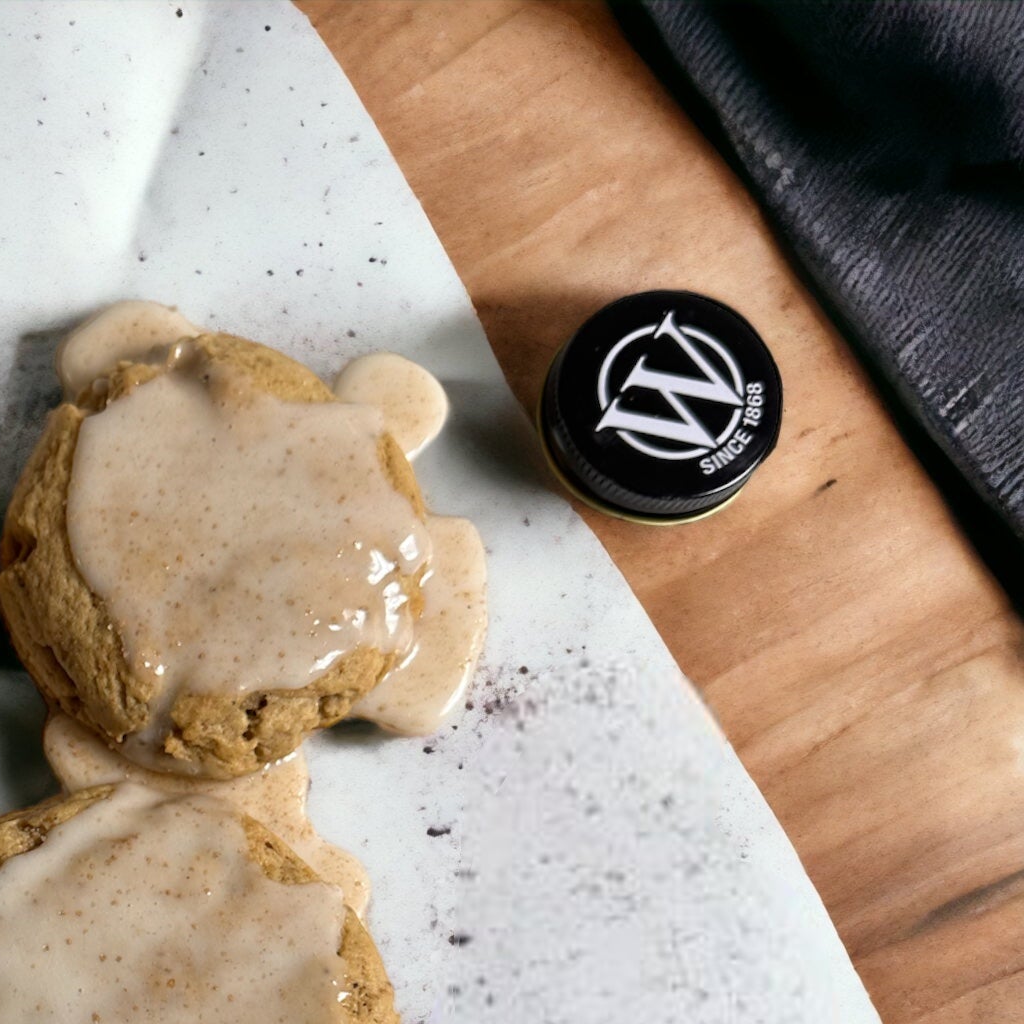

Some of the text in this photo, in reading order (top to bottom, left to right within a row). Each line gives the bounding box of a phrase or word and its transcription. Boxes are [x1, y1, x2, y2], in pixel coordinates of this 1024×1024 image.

[595, 311, 744, 448] W
[699, 382, 763, 475] SINCE 1868
